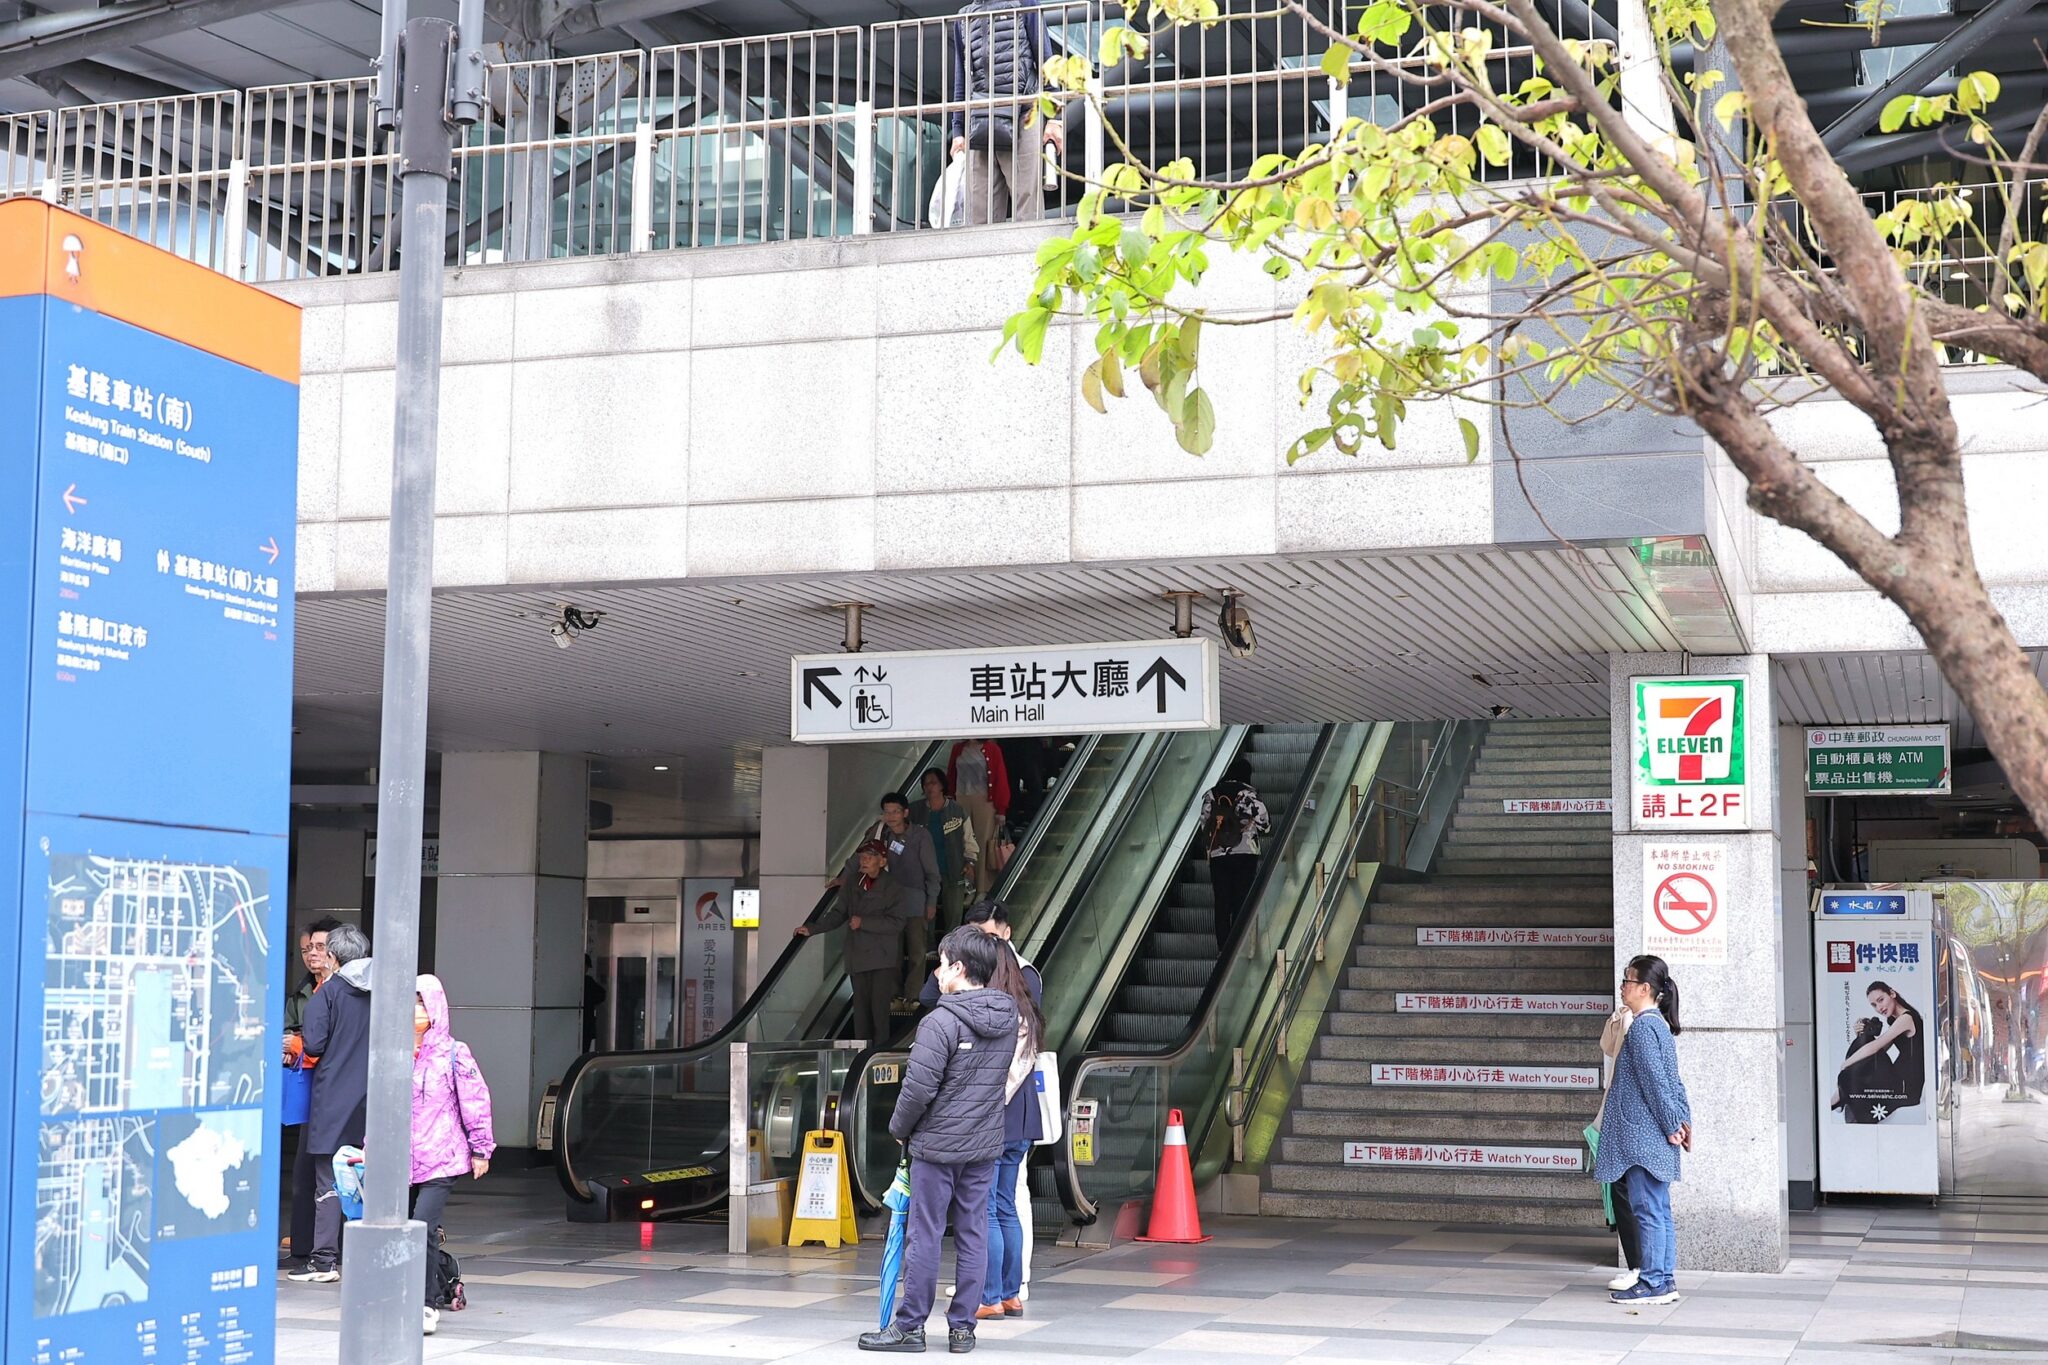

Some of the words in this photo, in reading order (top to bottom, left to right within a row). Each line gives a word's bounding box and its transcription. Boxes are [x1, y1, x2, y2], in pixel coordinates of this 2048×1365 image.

[66, 363, 193, 432] 基隆車站(南)
[65, 405, 110, 435] Keelung
[110, 418, 137, 441] Train
[137, 427, 174, 451] Station
[175, 438, 211, 464] (South)
[969, 658, 1130, 702] 車站大廳
[971, 706, 1009, 723] Main
[1014, 704, 1045, 722] Hall
[1829, 731, 1885, 744] 中華郵政
[1924, 734, 1941, 742] POST
[1816, 751, 1893, 766] 自動櫃員機
[1898, 751, 1924, 764] ATM
[1815, 771, 1893, 785] 票品出售機
[1507, 799, 1606, 812] 上下階梯請小心行走
[1642, 792, 1741, 819] 請上2F
[1657, 863, 1671, 871] NO
[1672, 863, 1715, 871] SMOKING
[1422, 929, 1540, 944] 上下階梯請小心行走
[1543, 933, 1572, 943] Watch
[1575, 934, 1598, 943] Your
[1400, 995, 1524, 1010] 上下階梯請小心行走
[1527, 1000, 1557, 1010] Watch
[1560, 1000, 1584, 1010] Your
[1586, 1001, 1609, 1012] Step
[1376, 1067, 1505, 1083] 上下階梯請小心行走
[1509, 1073, 1541, 1084] Watch
[1543, 1073, 1569, 1084] Your
[1570, 1074, 1595, 1085] Step
[1349, 1146, 1483, 1163] 上下階梯請小心行走
[1488, 1152, 1521, 1164] Watch
[1524, 1153, 1550, 1164] Your
[1552, 1154, 1578, 1166] Step
